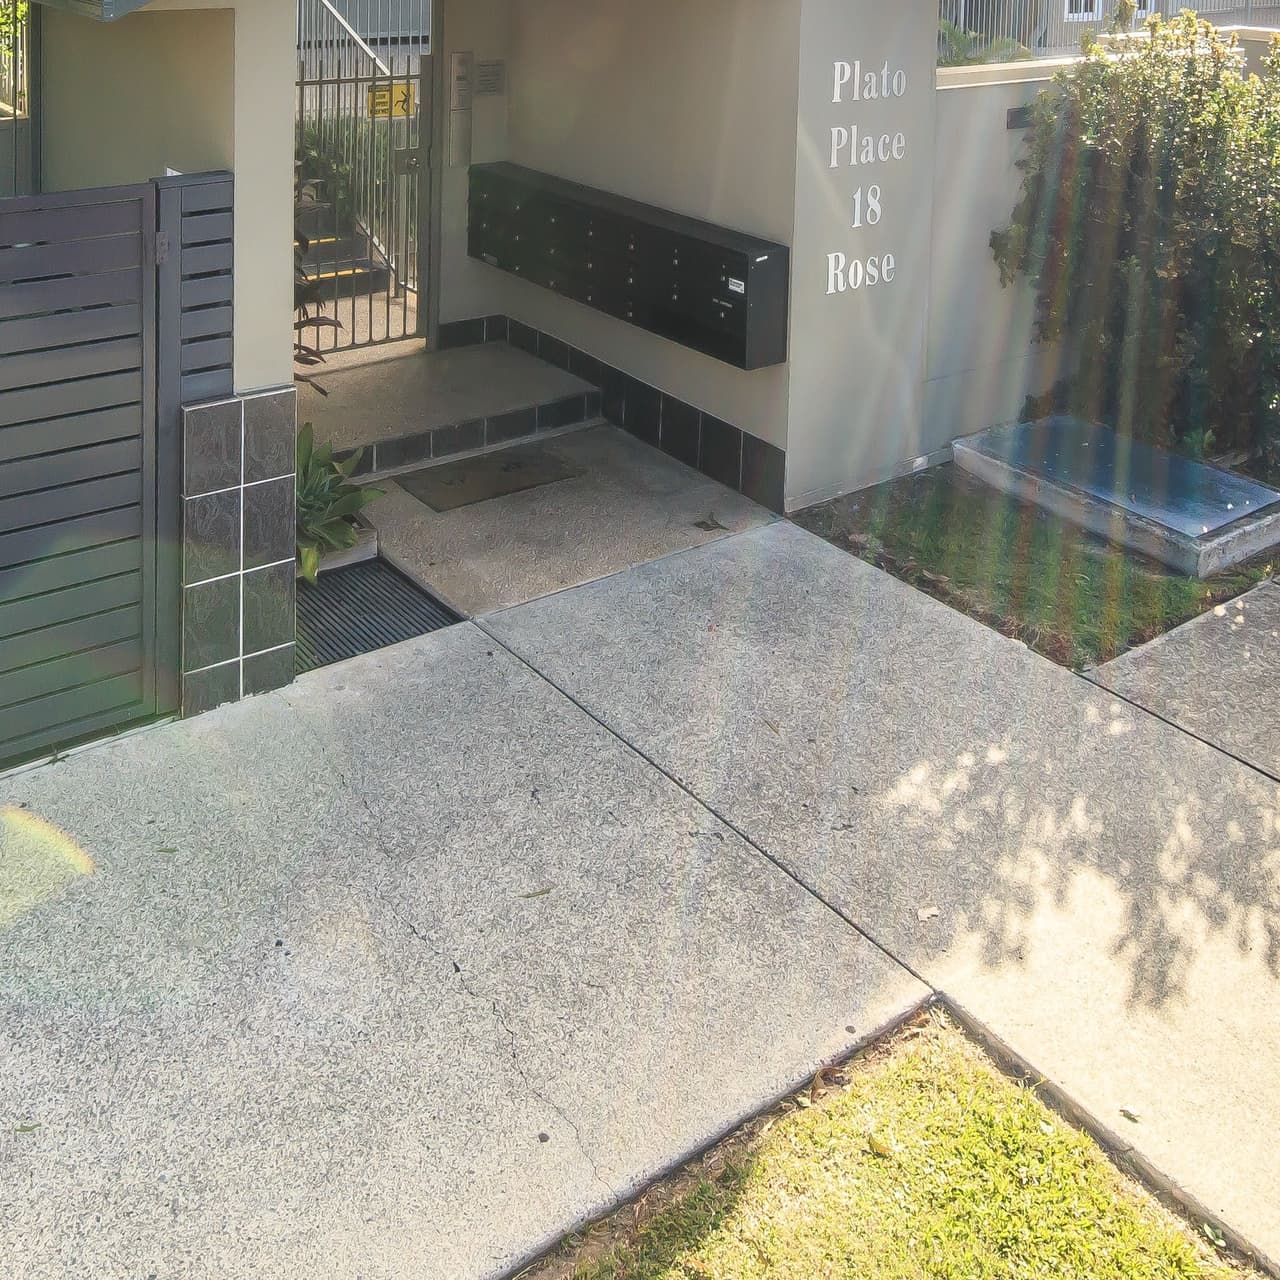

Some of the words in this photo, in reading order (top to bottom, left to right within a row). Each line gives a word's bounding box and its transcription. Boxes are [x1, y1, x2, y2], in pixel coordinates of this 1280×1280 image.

[831, 60, 907, 103] Plato
[828, 124, 906, 168] Place
[851, 184, 882, 228] 18
[825, 251, 896, 295] Rose
